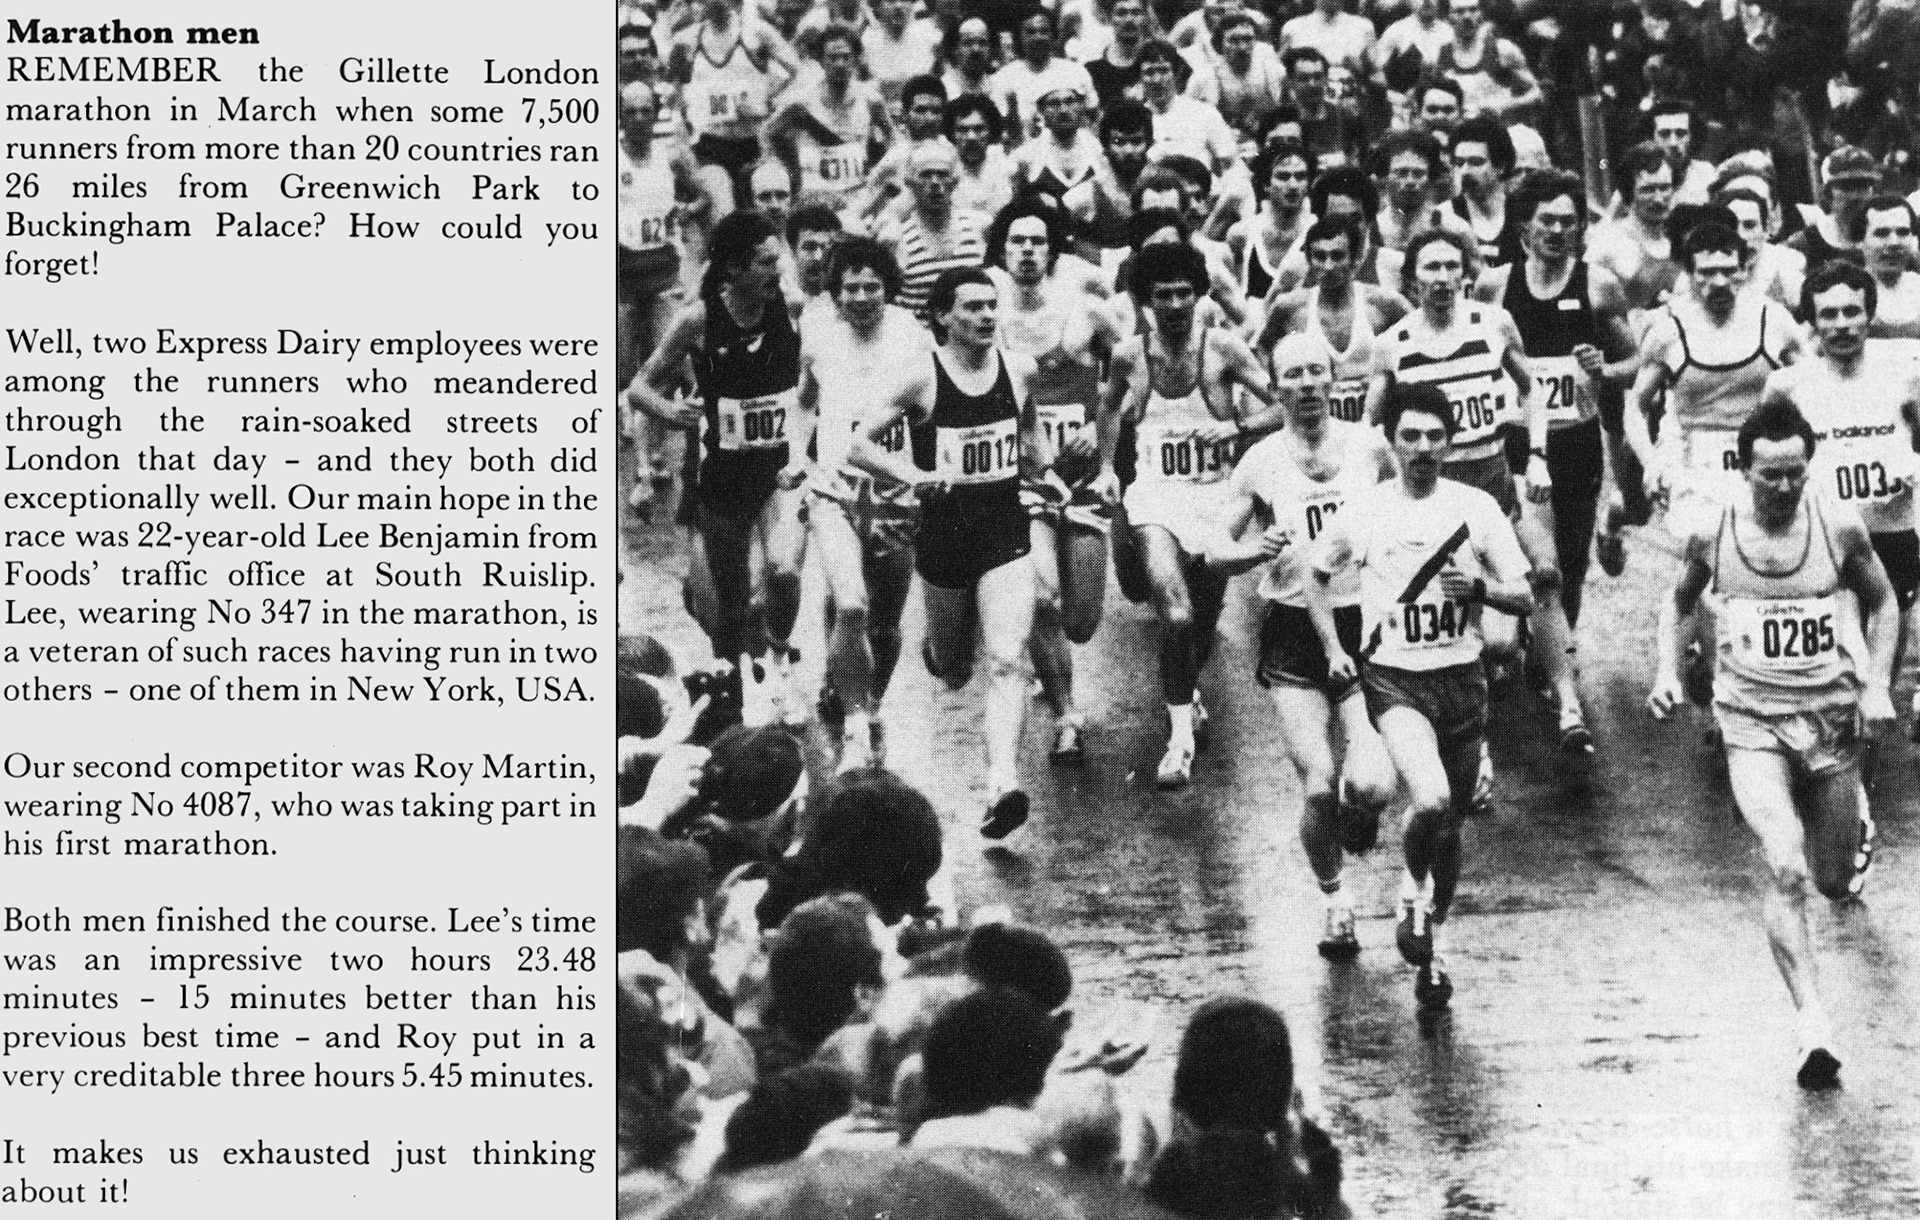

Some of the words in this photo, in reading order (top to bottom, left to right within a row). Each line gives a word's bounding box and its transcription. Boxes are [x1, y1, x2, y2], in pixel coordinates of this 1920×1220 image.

[7, 19, 173, 44] Marathon
[187, 28, 259, 44] men
[7, 57, 221, 82] REMEMBER
[259, 57, 303, 82] the
[340, 57, 448, 83] Gillette
[484, 59, 599, 84] London
[6, 96, 150, 121] marathon
[171, 96, 197, 121] in
[218, 96, 316, 121] March
[336, 97, 413, 122] when
[431, 106, 503, 123] some
[522, 98, 599, 129] 7,500
[7, 143, 117, 159] runners
[127, 134, 195, 159] from
[206, 143, 279, 159] more
[290, 135, 355, 160] than
[366, 135, 399, 161] 20
[408, 137, 541, 161] countries
[550, 146, 598, 162] ran
[6, 173, 39, 198] 26
[73, 173, 147, 198] miles
[179, 173, 248, 198] from
[281, 173, 440, 199] Greenwich
[472, 175, 540, 200] Park
[572, 181, 599, 200] to
[6, 211, 191, 244] Buckingham
[216, 212, 325, 237] Palace?
[349, 213, 419, 238] How
[442, 214, 522, 239] could
[546, 223, 598, 247] you
[5, 250, 97, 283] forget!
[6, 329, 81, 359] Well,
[93, 334, 146, 353] two
[156, 329, 267, 361] Express
[277, 329, 360, 362] Dairy
[370, 330, 521, 363] employees
[530, 340, 598, 356] were
[5, 376, 105, 400] among
[134, 367, 178, 392] the
[208, 376, 318, 393] runners
[347, 368, 407, 393] who
[434, 369, 597, 394] meandered
[6, 407, 121, 439] through
[160, 406, 204, 432] the
[242, 407, 411, 433] rain-soaked
[447, 414, 537, 433] streets
[572, 408, 602, 433] of
[963, 433, 1018, 476] 0012
[5, 484, 199, 517] exceptionally
[210, 484, 275, 509] well.
[288, 484, 349, 509] Our
[358, 485, 431, 510] main
[440, 485, 509, 518] hope
[518, 486, 545, 510] in
[553, 486, 597, 510] the
[5, 531, 65, 547] race
[76, 531, 128, 547] was
[138, 522, 305, 555] 22-year-old
[317, 523, 369, 548] Lee
[379, 524, 519, 555] Benjamin
[529, 523, 597, 548] from
[5, 561, 98, 586] Foods’
[122, 560, 207, 585] traffic
[229, 561, 305, 586] office
[327, 568, 353, 586] at
[377, 562, 461, 586] South
[483, 562, 594, 595] Ruislip.
[5, 600, 65, 629] Lee,
[78, 599, 196, 632] wearing
[208, 599, 250, 624] No
[262, 599, 311, 624] 347
[323, 599, 349, 624] in
[360, 599, 404, 624] the
[414, 600, 566, 630] marathon,
[578, 600, 597, 625] is
[1404, 601, 1469, 643] 0347
[1763, 613, 1835, 658] 0285
[4, 647, 19, 662] a
[29, 643, 138, 662] veteran
[148, 637, 178, 662] of
[184, 637, 247, 662] such
[259, 646, 330, 662] races
[341, 638, 441, 671] having
[450, 647, 500, 663] run
[510, 638, 536, 663] in
[545, 644, 597, 663] two
[4, 753, 65, 778] Our
[74, 753, 171, 778] second
[181, 753, 343, 786] competitor
[351, 762, 404, 778] was
[414, 754, 473, 786] Roy
[482, 754, 595, 784] Martin,
[4, 792, 122, 824] wearing
[131, 792, 173, 816] No
[183, 791, 260, 822] 4087,
[272, 791, 332, 816] who
[341, 800, 393, 817] was
[402, 792, 493, 825] taking
[502, 798, 561, 825] part
[570, 793, 596, 817] in
[4, 831, 42, 855] his
[56, 830, 110, 855] first
[125, 830, 276, 855] marathon.
[4, 907, 70, 932] Both
[83, 916, 145, 932] men
[157, 906, 269, 932] finished
[282, 907, 326, 932] the
[336, 916, 435, 932] course.
[448, 908, 522, 932] Lee’s
[532, 908, 595, 932] time
[4, 954, 55, 970] was
[85, 954, 119, 970] an
[151, 946, 301, 978] impressive
[331, 952, 383, 971] two
[411, 946, 490, 971] hours
[518, 946, 595, 972] 23.48
[4, 984, 118, 1009] minutes
[180, 985, 209, 1009] 15
[231, 984, 345, 1009] minutes
[366, 985, 452, 1009] better
[471, 985, 536, 1010] than
[557, 985, 595, 1010] his
[3, 1071, 64, 1094] very
[75, 1062, 221, 1087] creditable
[232, 1062, 305, 1087] three
[315, 1062, 394, 1087] hours
[403, 1063, 462, 1087] 5.45
[471, 1063, 592, 1088] minutes.
[4, 1140, 25, 1163] It
[53, 1139, 142, 1164] makes
[169, 1148, 198, 1164] us
[224, 1139, 369, 1165] exhausted
[391, 1140, 446, 1172] just
[473, 1140, 596, 1173] thinking
[2, 1178, 85, 1203] about
[101, 1178, 127, 1203] it!
